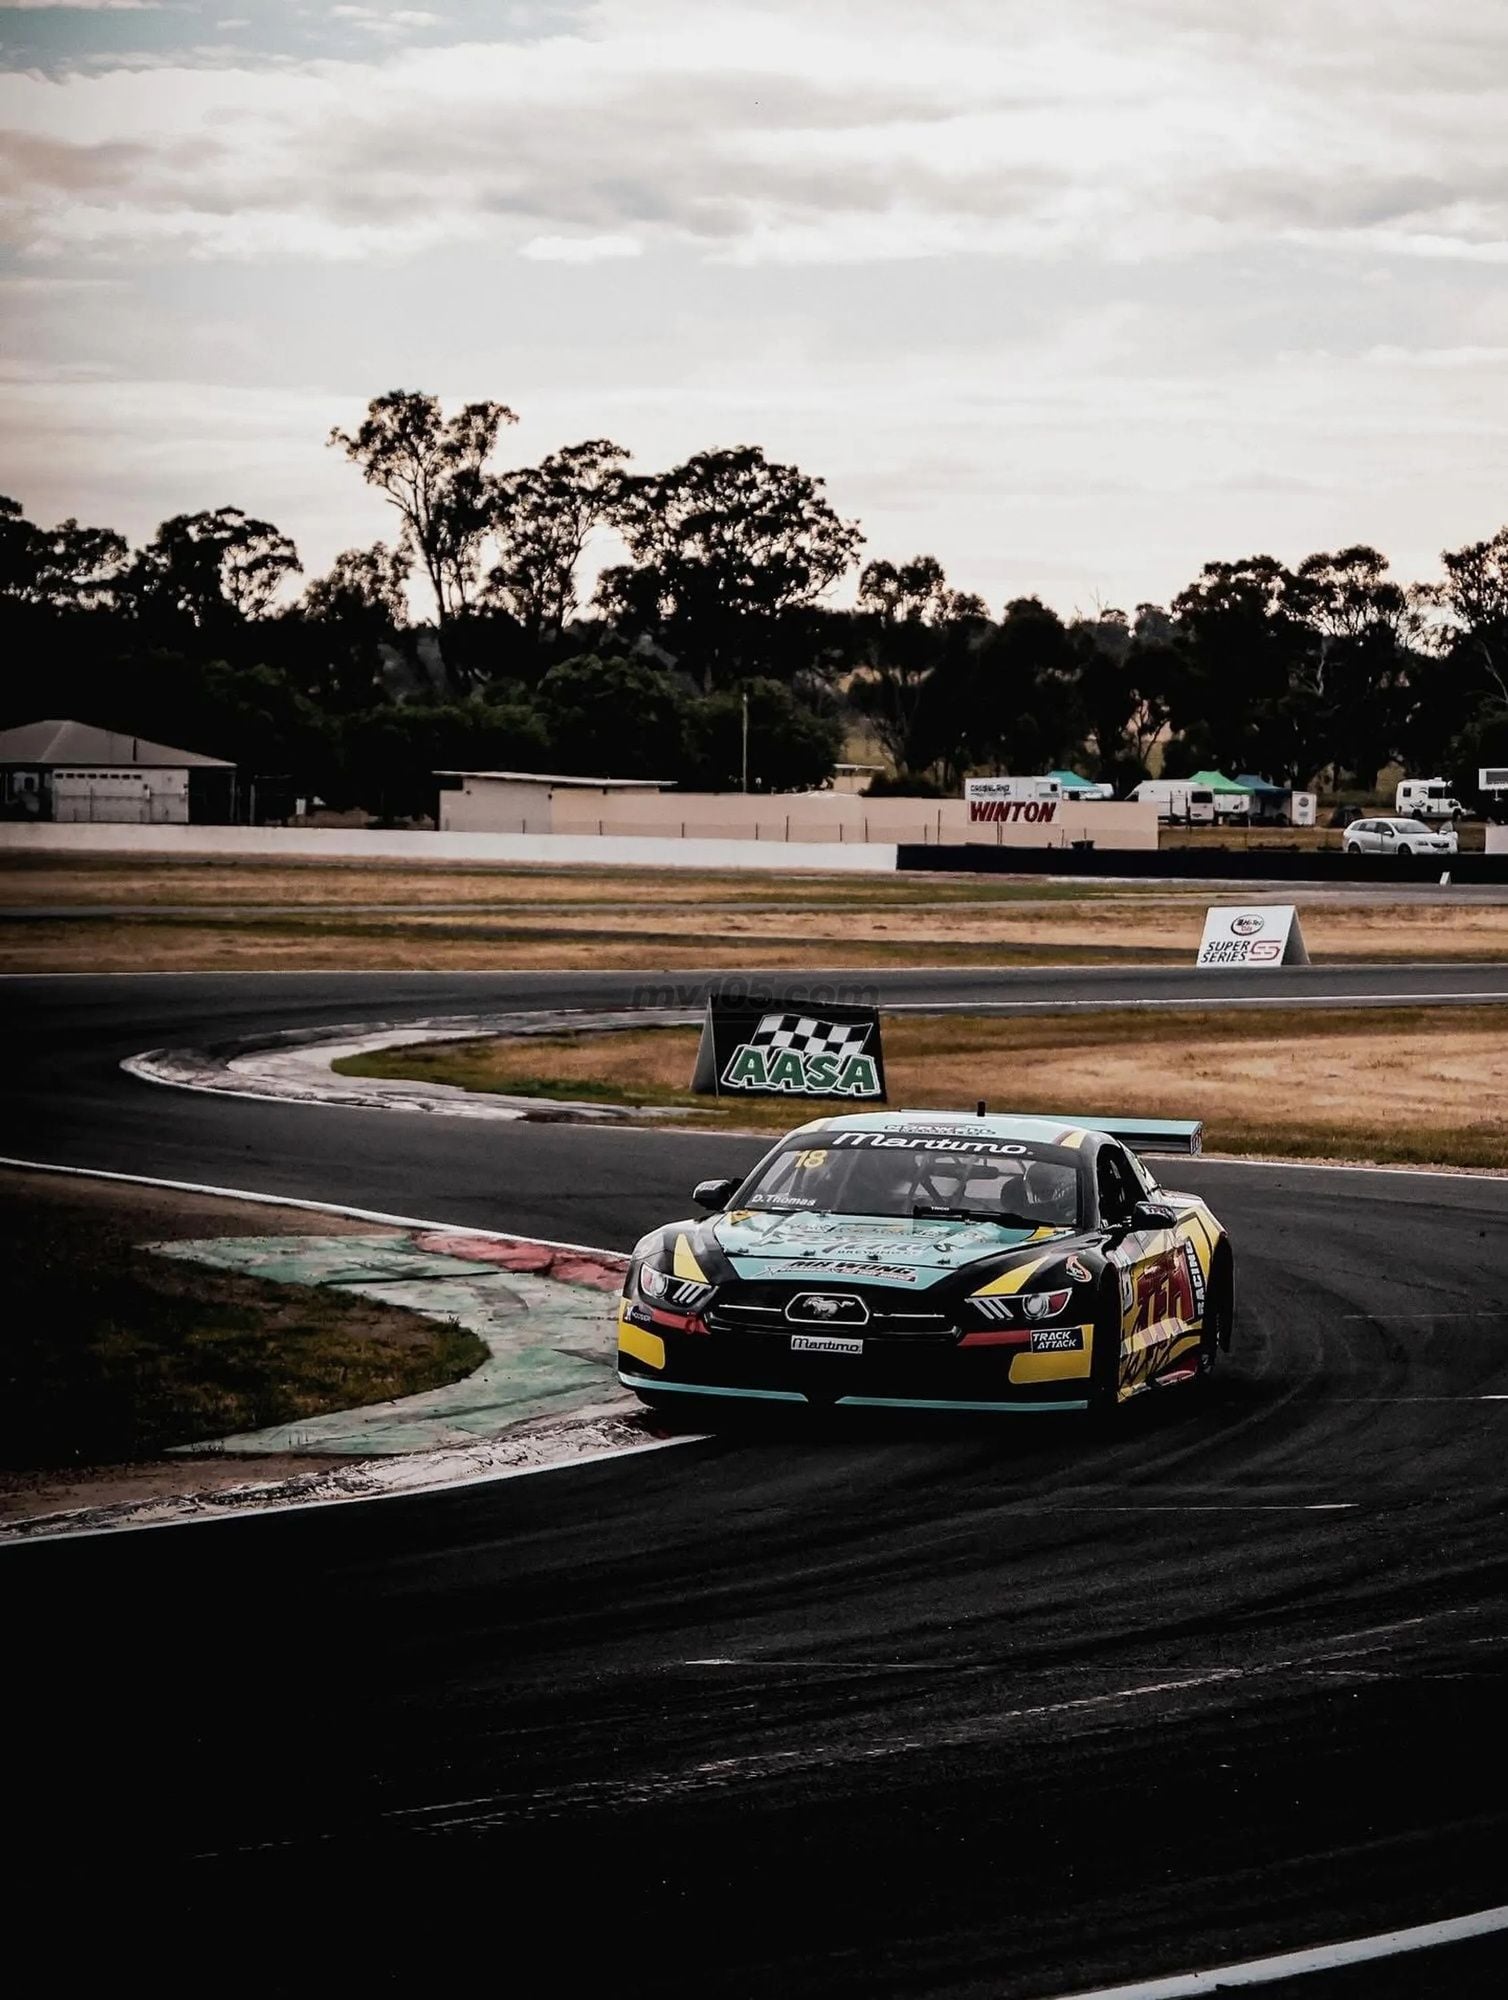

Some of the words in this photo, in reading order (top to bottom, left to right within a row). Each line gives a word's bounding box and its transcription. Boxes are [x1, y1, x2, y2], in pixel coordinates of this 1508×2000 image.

[970, 801, 1057, 823] WINTON
[1206, 941, 1251, 952] SUPER
[1200, 951, 1248, 963] SERIES
[721, 1044, 882, 1096] AASA
[832, 1132, 1027, 1154] Maritimo
[794, 1149, 828, 1168] 18
[766, 1194, 817, 1206] Thomas
[1032, 1331, 1072, 1342] TRACK
[793, 1337, 860, 1353] Maritimo
[1037, 1339, 1077, 1350] ATTACK
